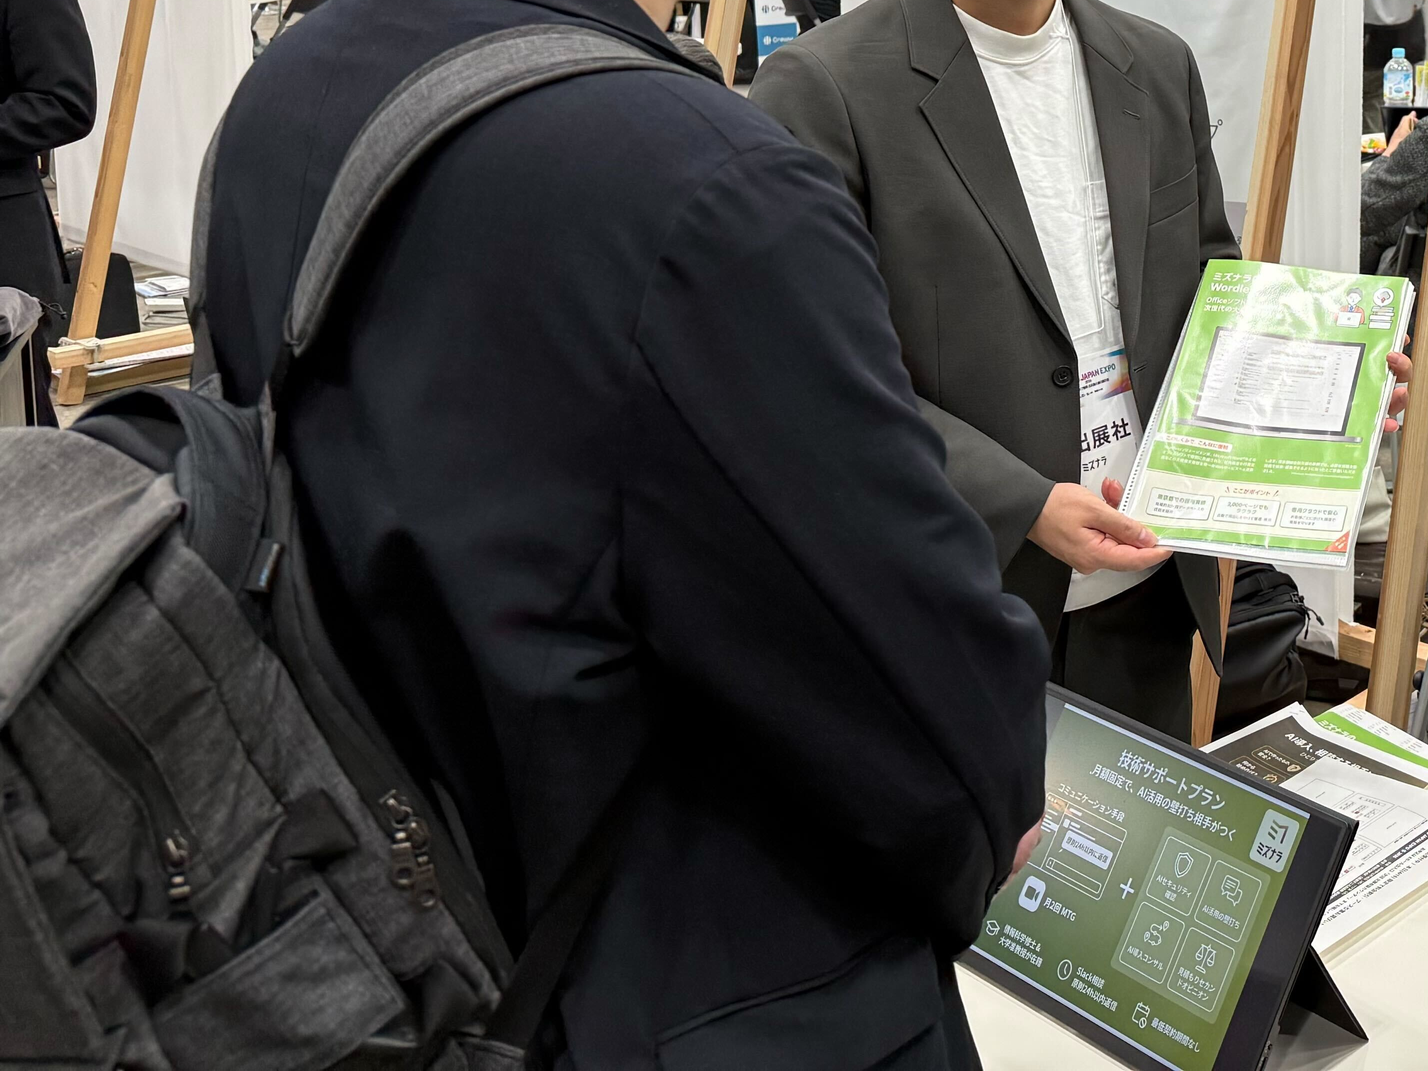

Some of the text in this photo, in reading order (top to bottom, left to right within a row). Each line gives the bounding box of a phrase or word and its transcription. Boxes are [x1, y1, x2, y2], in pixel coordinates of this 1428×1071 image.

[1117, 749, 1226, 811] 技術サポートプラン
[1057, 783, 1127, 823] コミュニケーション手段
[1255, 842, 1284, 865] ミズナラ
